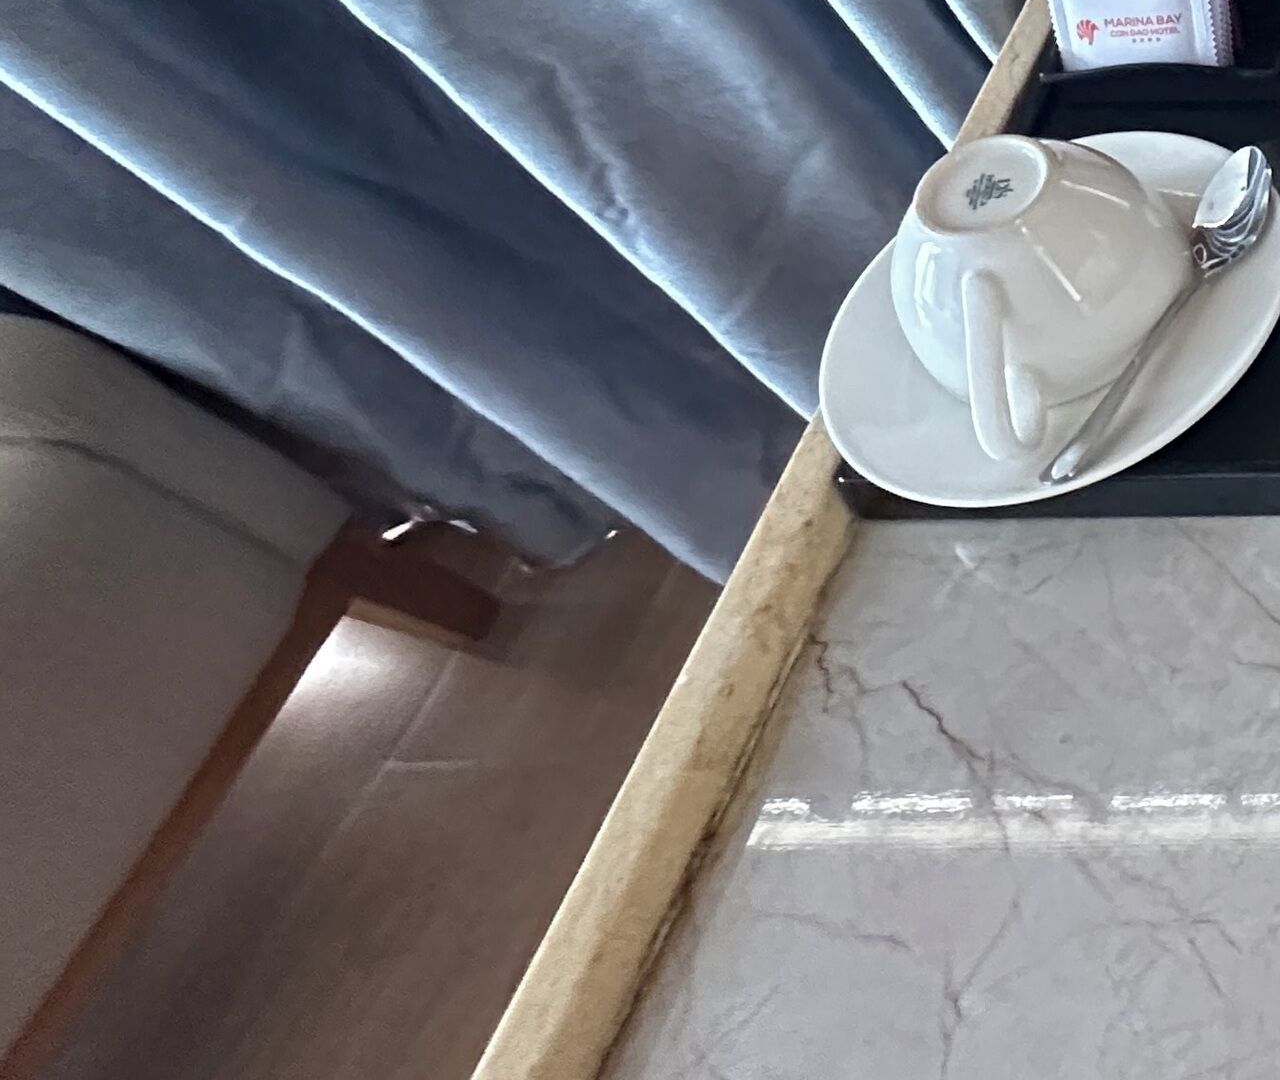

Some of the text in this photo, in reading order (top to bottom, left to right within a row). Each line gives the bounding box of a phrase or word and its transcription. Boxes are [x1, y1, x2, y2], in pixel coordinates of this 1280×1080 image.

[1103, 13, 1182, 29] MARINA BAY
[1110, 29, 1128, 38] CON
[1150, 26, 1181, 35] HOTEL
